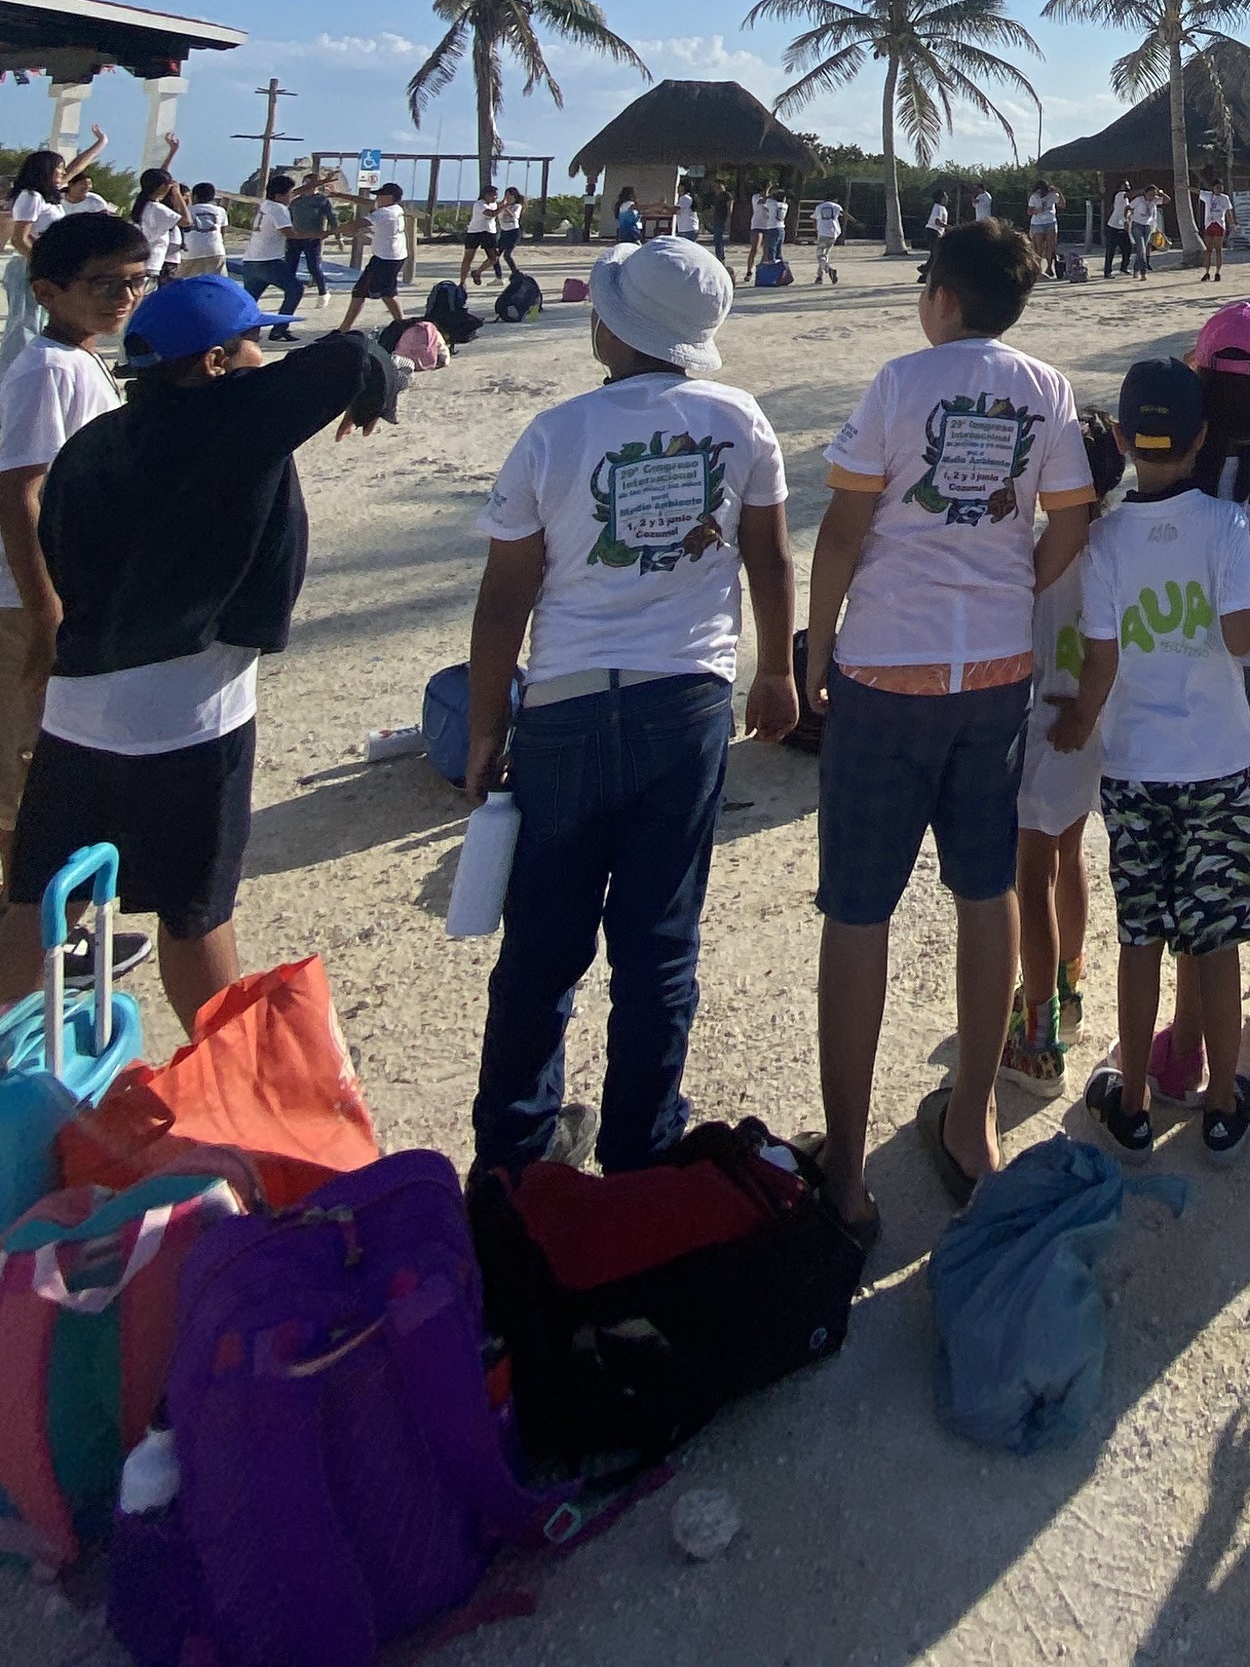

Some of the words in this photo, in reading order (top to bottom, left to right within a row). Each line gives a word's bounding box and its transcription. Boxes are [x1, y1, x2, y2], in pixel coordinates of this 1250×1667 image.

[643, 460, 699, 474] Congreso
[953, 471, 959, 480] 2
[976, 472, 999, 482] junio
[948, 483, 986, 492] Cozumel
[654, 497, 702, 510] Ambiente
[639, 518, 646, 527] 2
[649, 519, 656, 528] y
[657, 517, 664, 526] 3
[666, 514, 692, 526] junio
[635, 526, 679, 539] Cozumel
[1120, 580, 1213, 654] AUA
